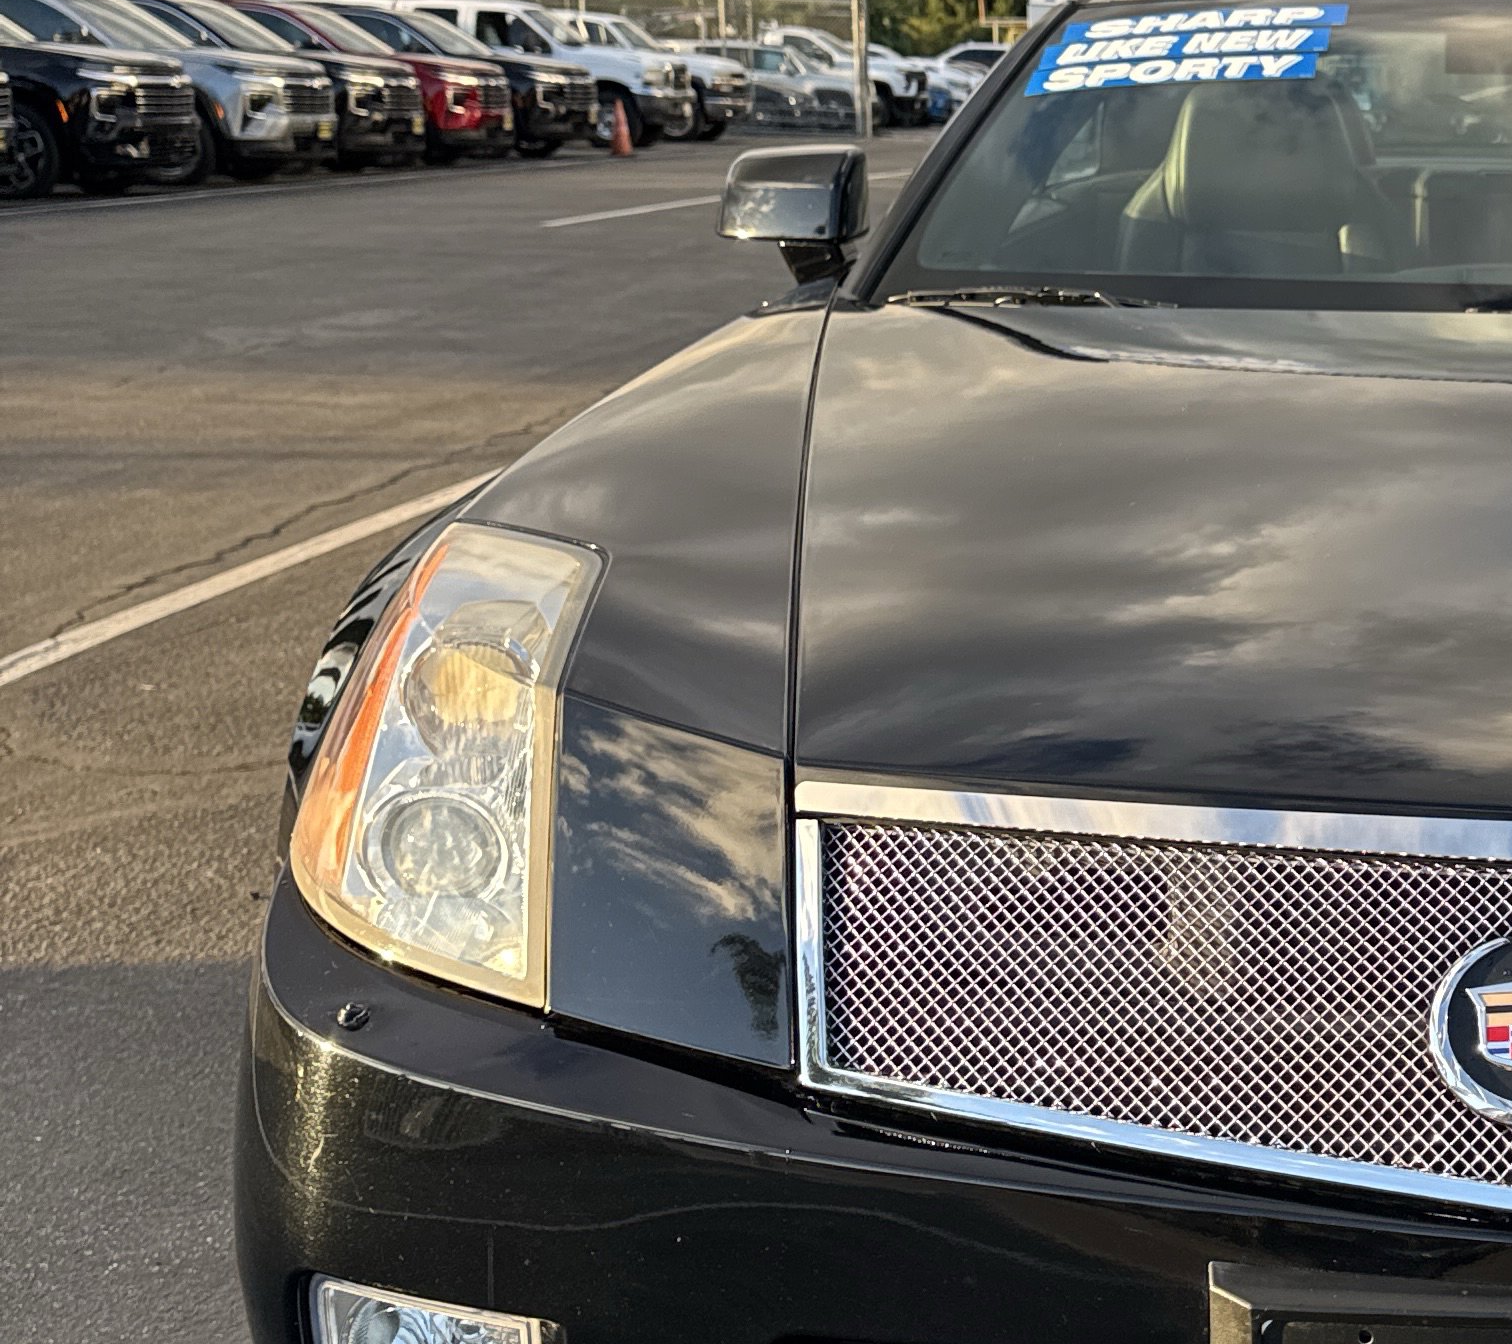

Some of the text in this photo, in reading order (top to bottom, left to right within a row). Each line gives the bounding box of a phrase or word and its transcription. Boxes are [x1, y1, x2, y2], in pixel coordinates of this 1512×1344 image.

[1085, 6, 1325, 38] SHARP
[1056, 28, 1314, 65] LIKE NEW
[1042, 54, 1304, 93] SPORTY
